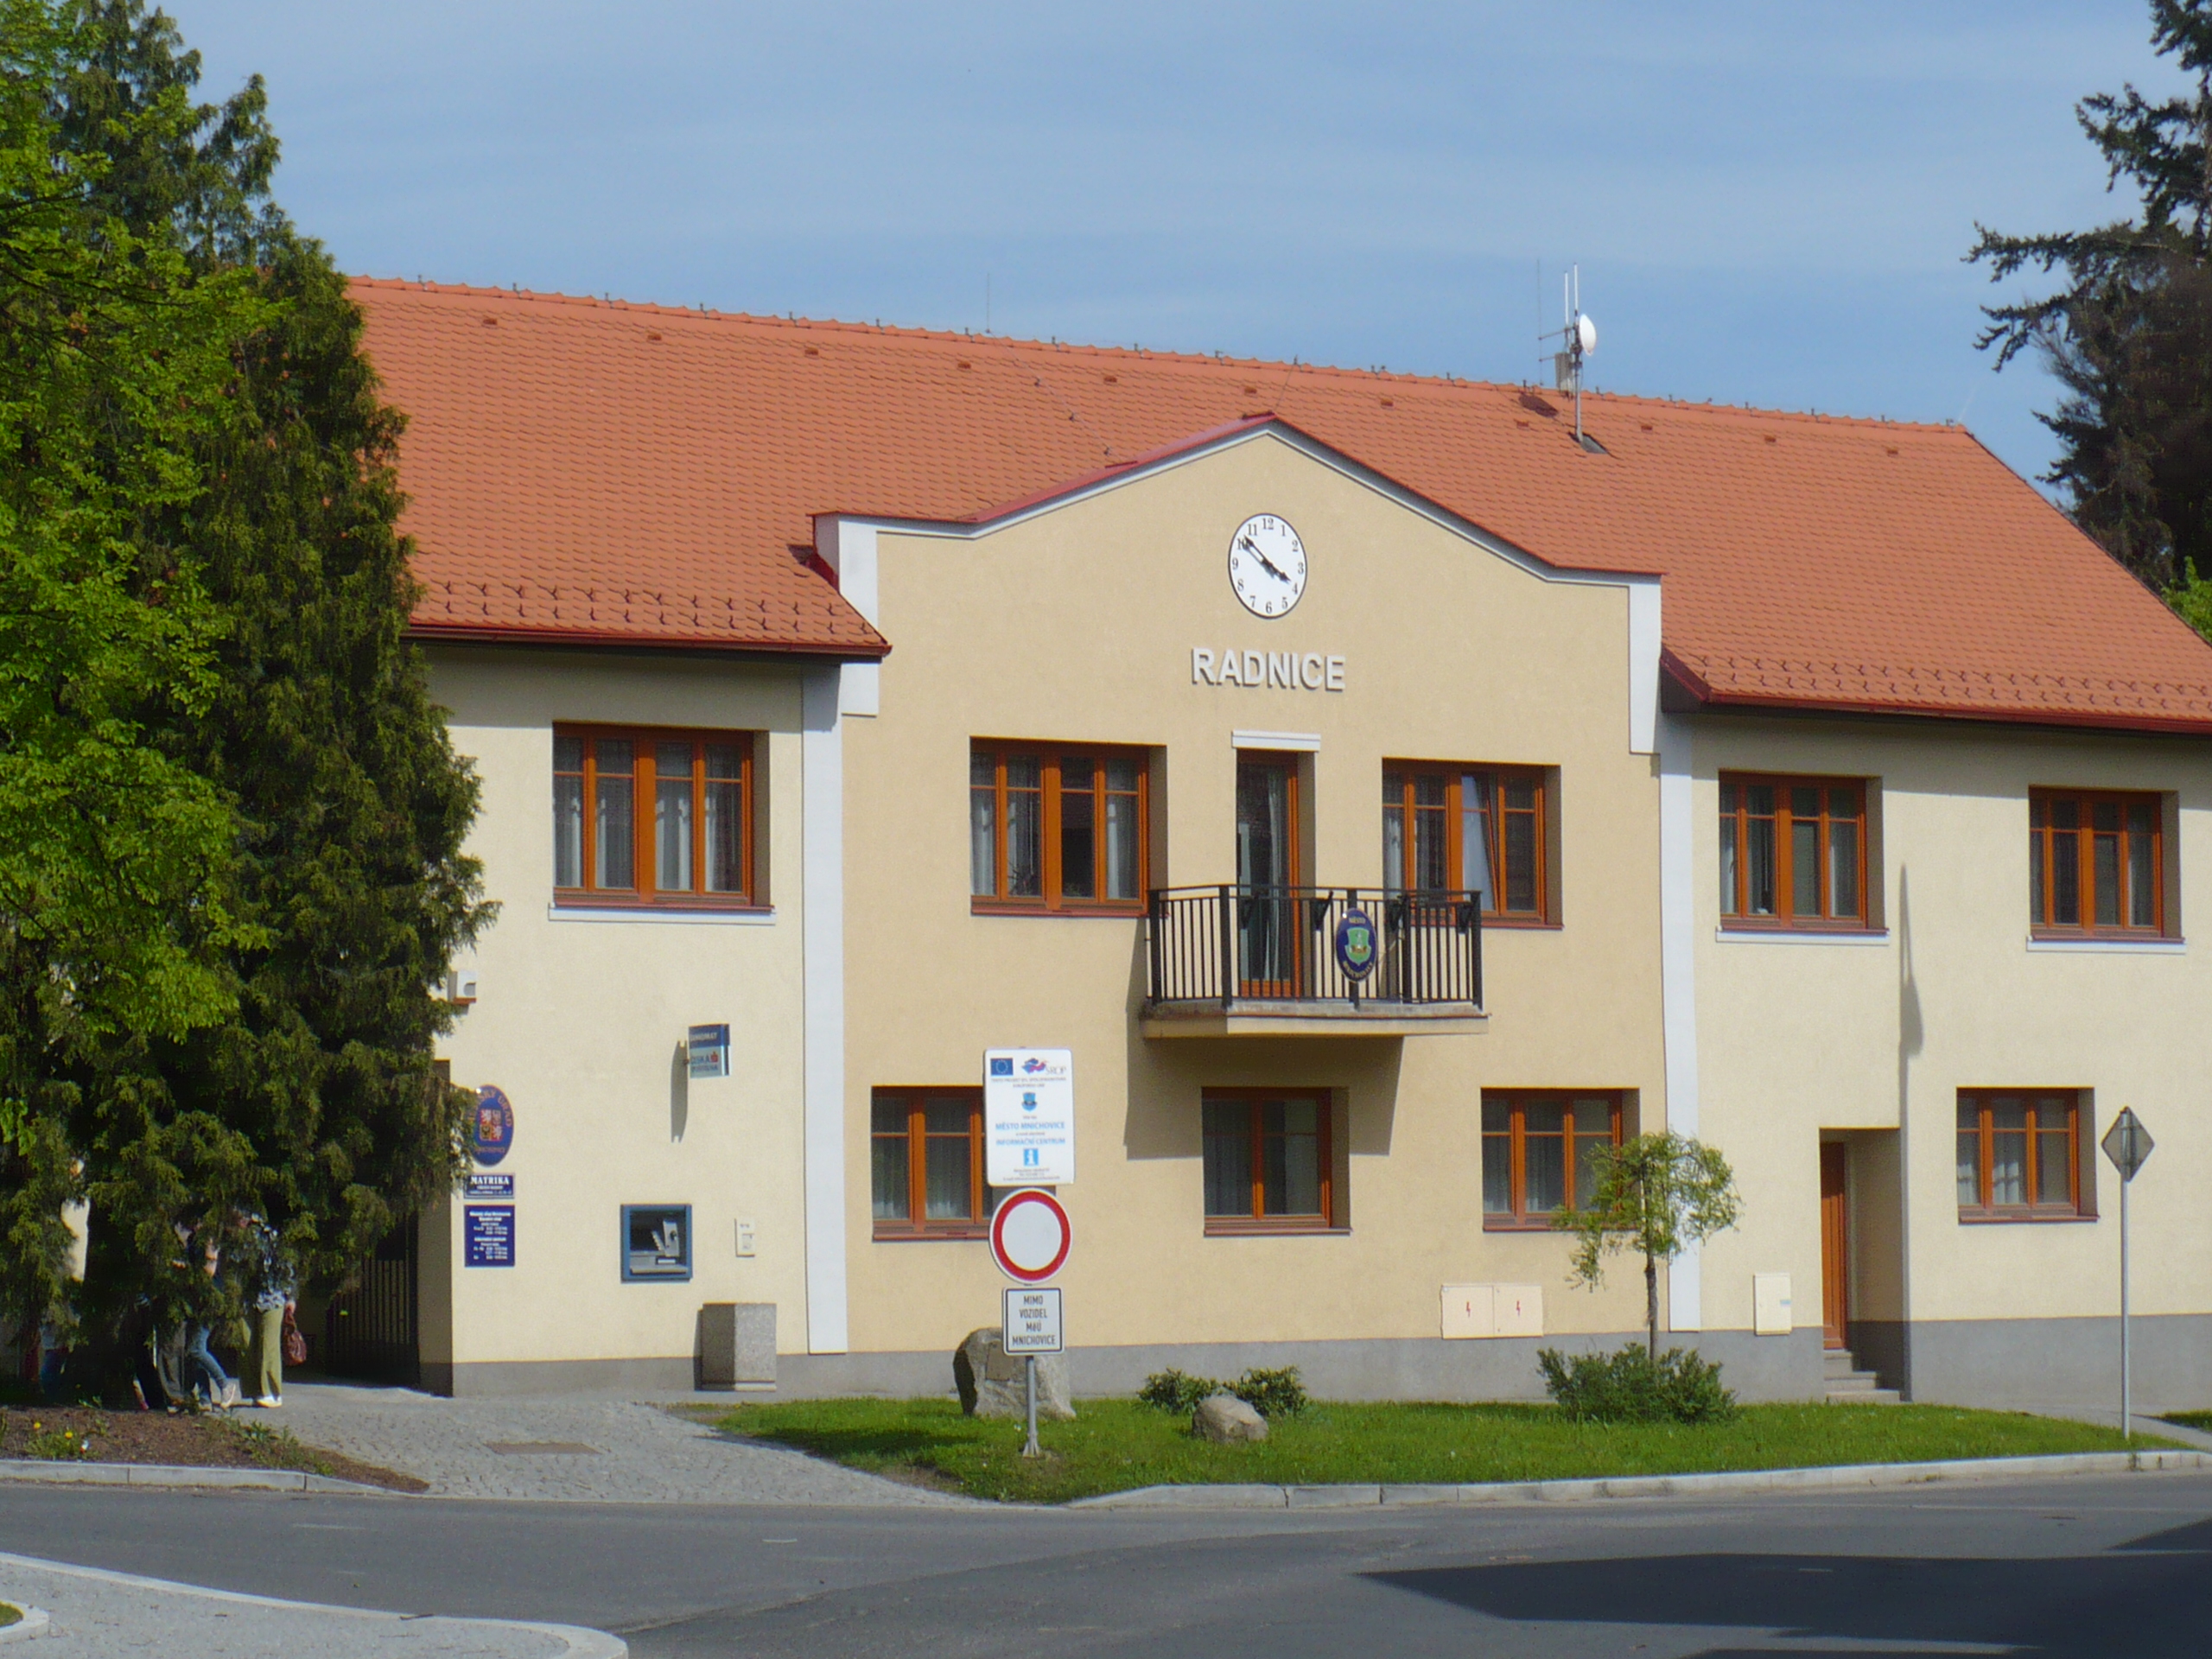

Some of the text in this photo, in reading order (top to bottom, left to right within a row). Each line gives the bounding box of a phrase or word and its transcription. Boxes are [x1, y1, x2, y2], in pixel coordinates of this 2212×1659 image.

[1247, 524, 1258, 536] 11
[1262, 518, 1274, 530] 12
[1281, 524, 1286, 537] 1
[1292, 540, 1299, 552] 2
[1232, 557, 1238, 570] 9
[1298, 563, 1304, 575] 3
[1237, 579, 1244, 591] 8
[1292, 582, 1298, 594] 4
[1249, 595, 1256, 608] 7
[1266, 601, 1272, 614] 6
[1281, 596, 1288, 609] 5
[1192, 647, 1346, 692] RADNICE
[995, 1122, 1065, 1130] MĚSTO MNICHOVICE
[995, 1137, 1066, 1147] INFORMAČNÍ CENTRUM
[470, 1176, 510, 1185] MATRIKA
[1023, 1295, 1044, 1306] MIMO
[1019, 1308, 1048, 1319] VOZIDEL
[1012, 1335, 1056, 1346] MNICHOVICE
